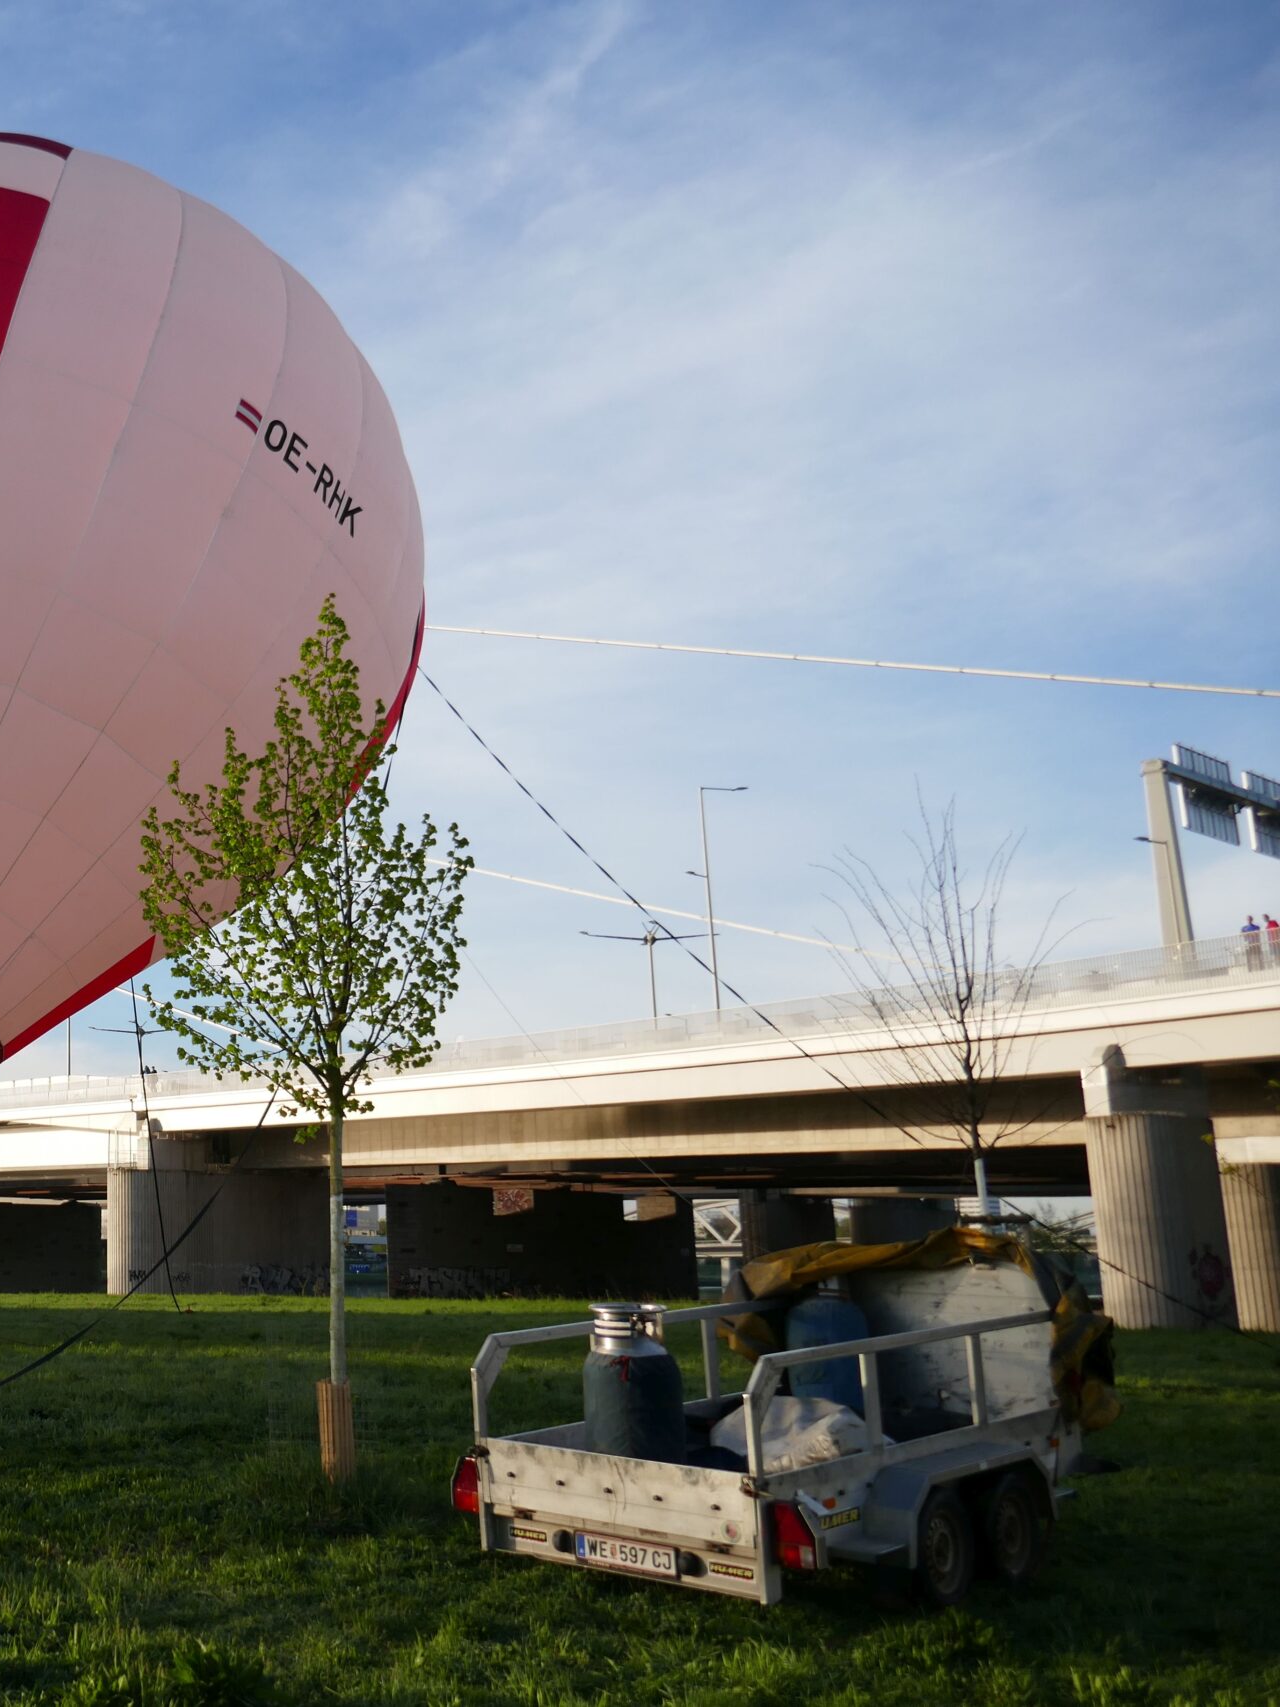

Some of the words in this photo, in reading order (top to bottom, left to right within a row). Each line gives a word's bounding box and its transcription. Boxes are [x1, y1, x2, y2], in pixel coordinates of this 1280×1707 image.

[264, 419, 363, 538] OE-RHK
[587, 1538, 608, 1559] WE
[620, 1545, 646, 1566] 597
[652, 1551, 672, 1570] CJ
